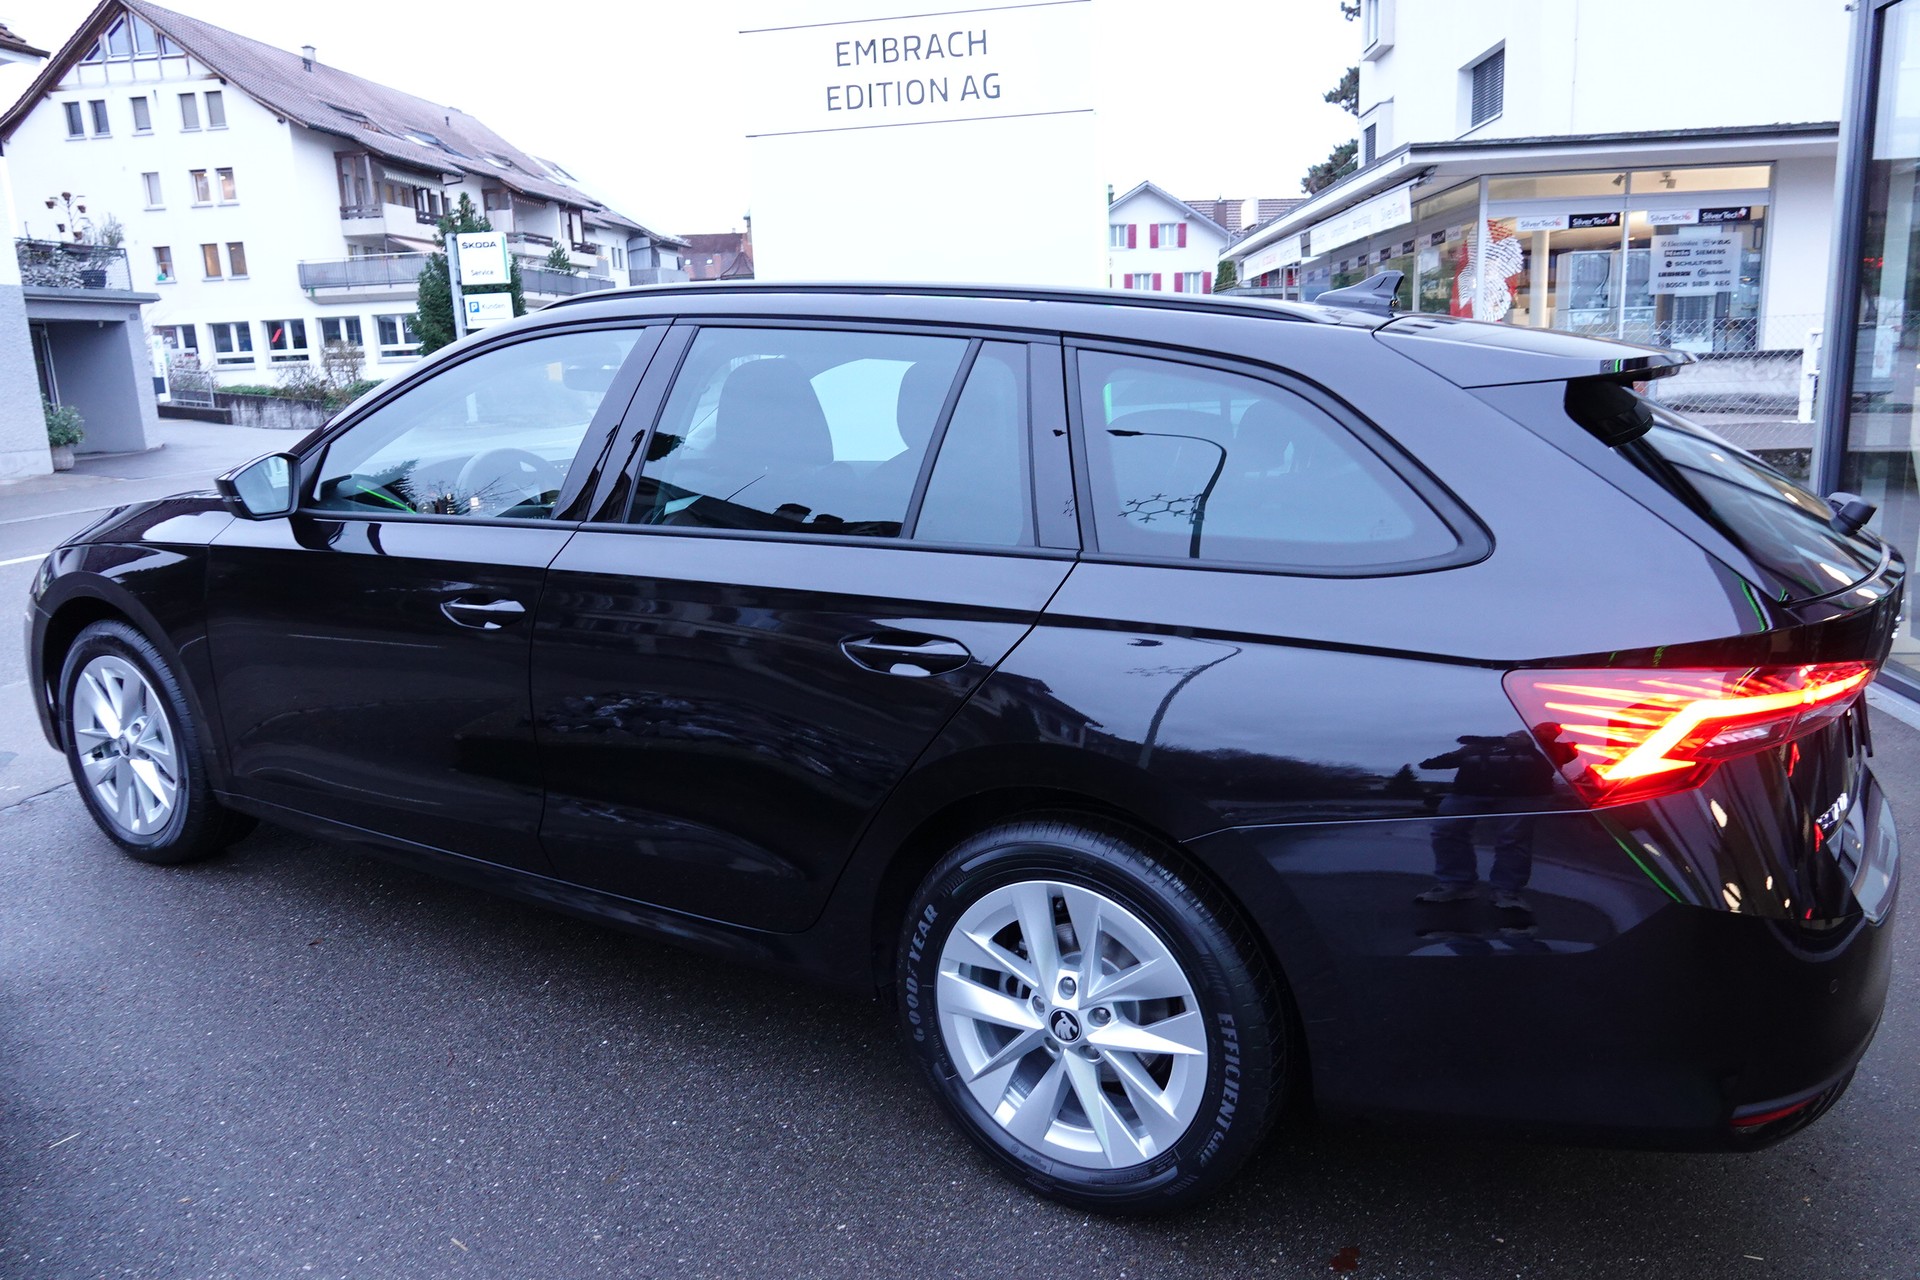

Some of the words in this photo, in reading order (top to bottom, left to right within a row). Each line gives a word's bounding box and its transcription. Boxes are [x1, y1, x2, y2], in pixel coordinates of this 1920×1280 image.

[836, 29, 987, 67] EMBRACH
[827, 77, 949, 111] EDITION
[960, 73, 1000, 101] AG
[462, 241, 497, 249] ŠKODA
[1217, 1012, 1240, 1131] EFFICIENT
